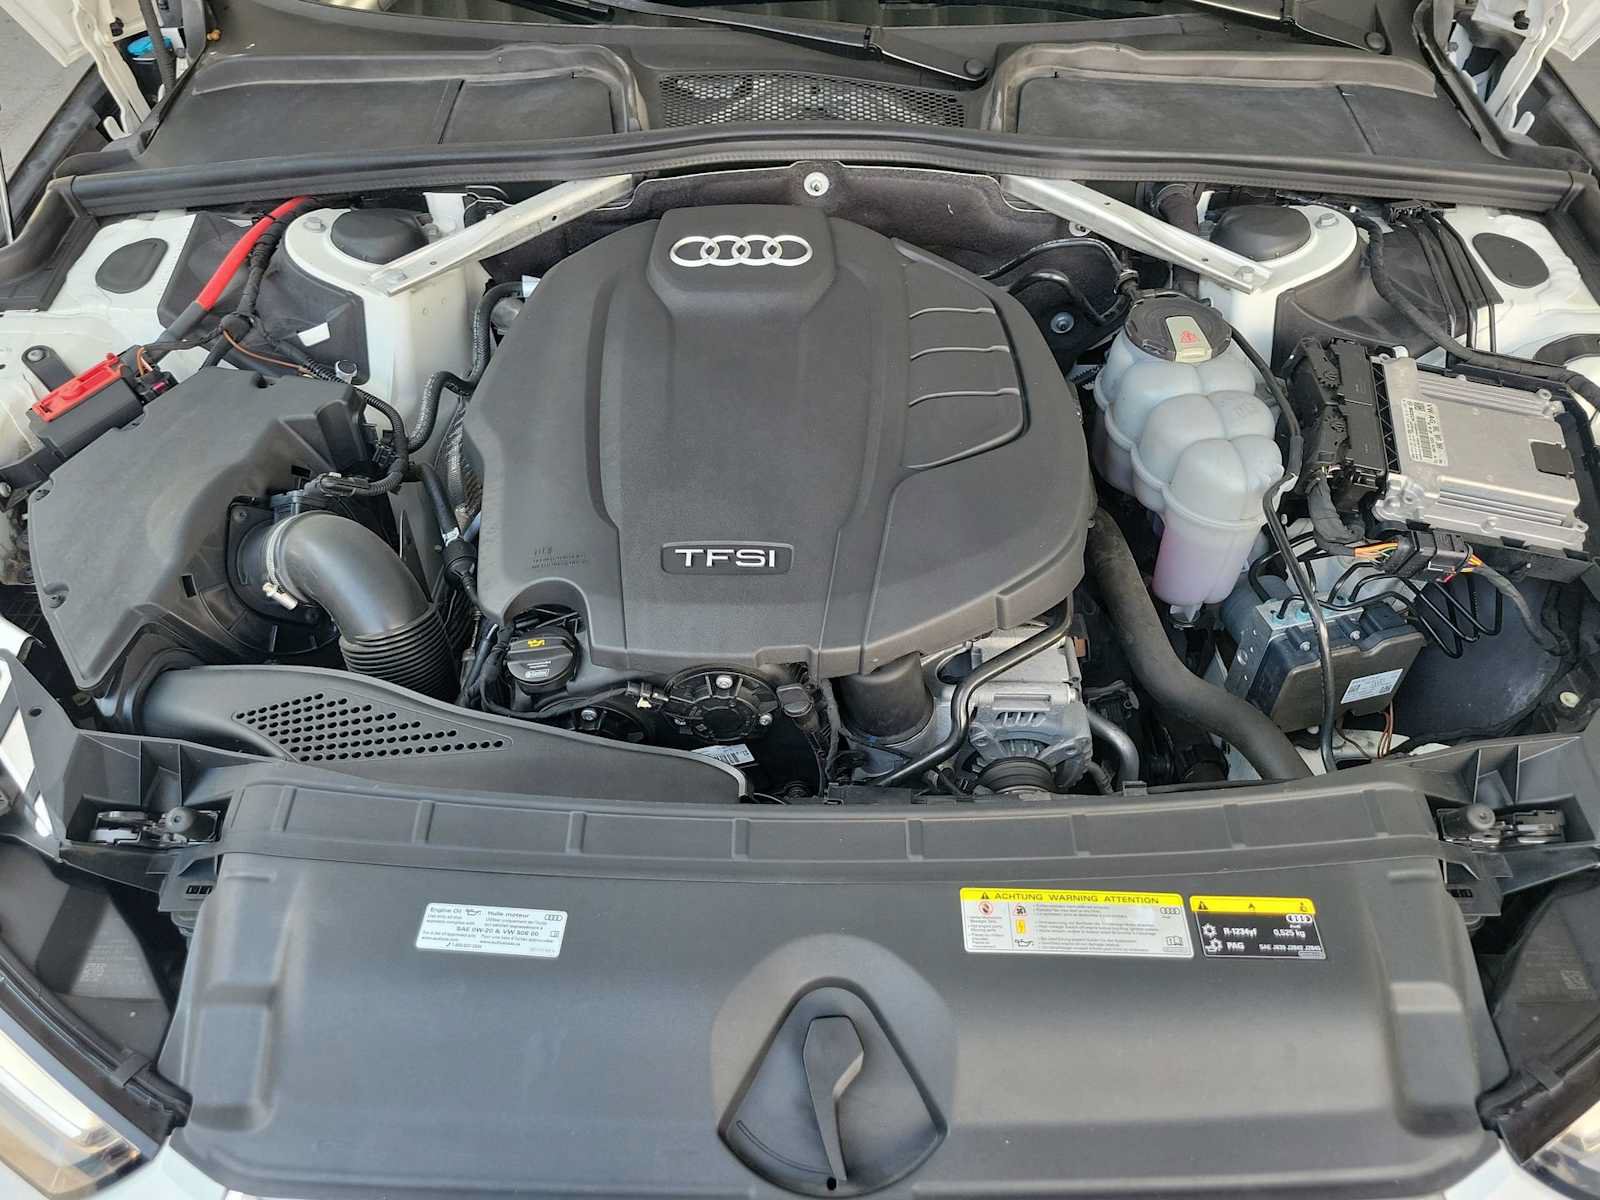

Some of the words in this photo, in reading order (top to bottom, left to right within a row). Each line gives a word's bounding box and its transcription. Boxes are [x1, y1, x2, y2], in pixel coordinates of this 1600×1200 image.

[674, 549, 775, 567] TFSI
[994, 892, 1043, 901] ACHTUNG
[1048, 894, 1098, 902] WARNING
[1103, 895, 1159, 904] ATTENTION
[1223, 927, 1257, 937] R-1234yf
[1295, 929, 1305, 938] kg
[1226, 941, 1245, 950] PAG
